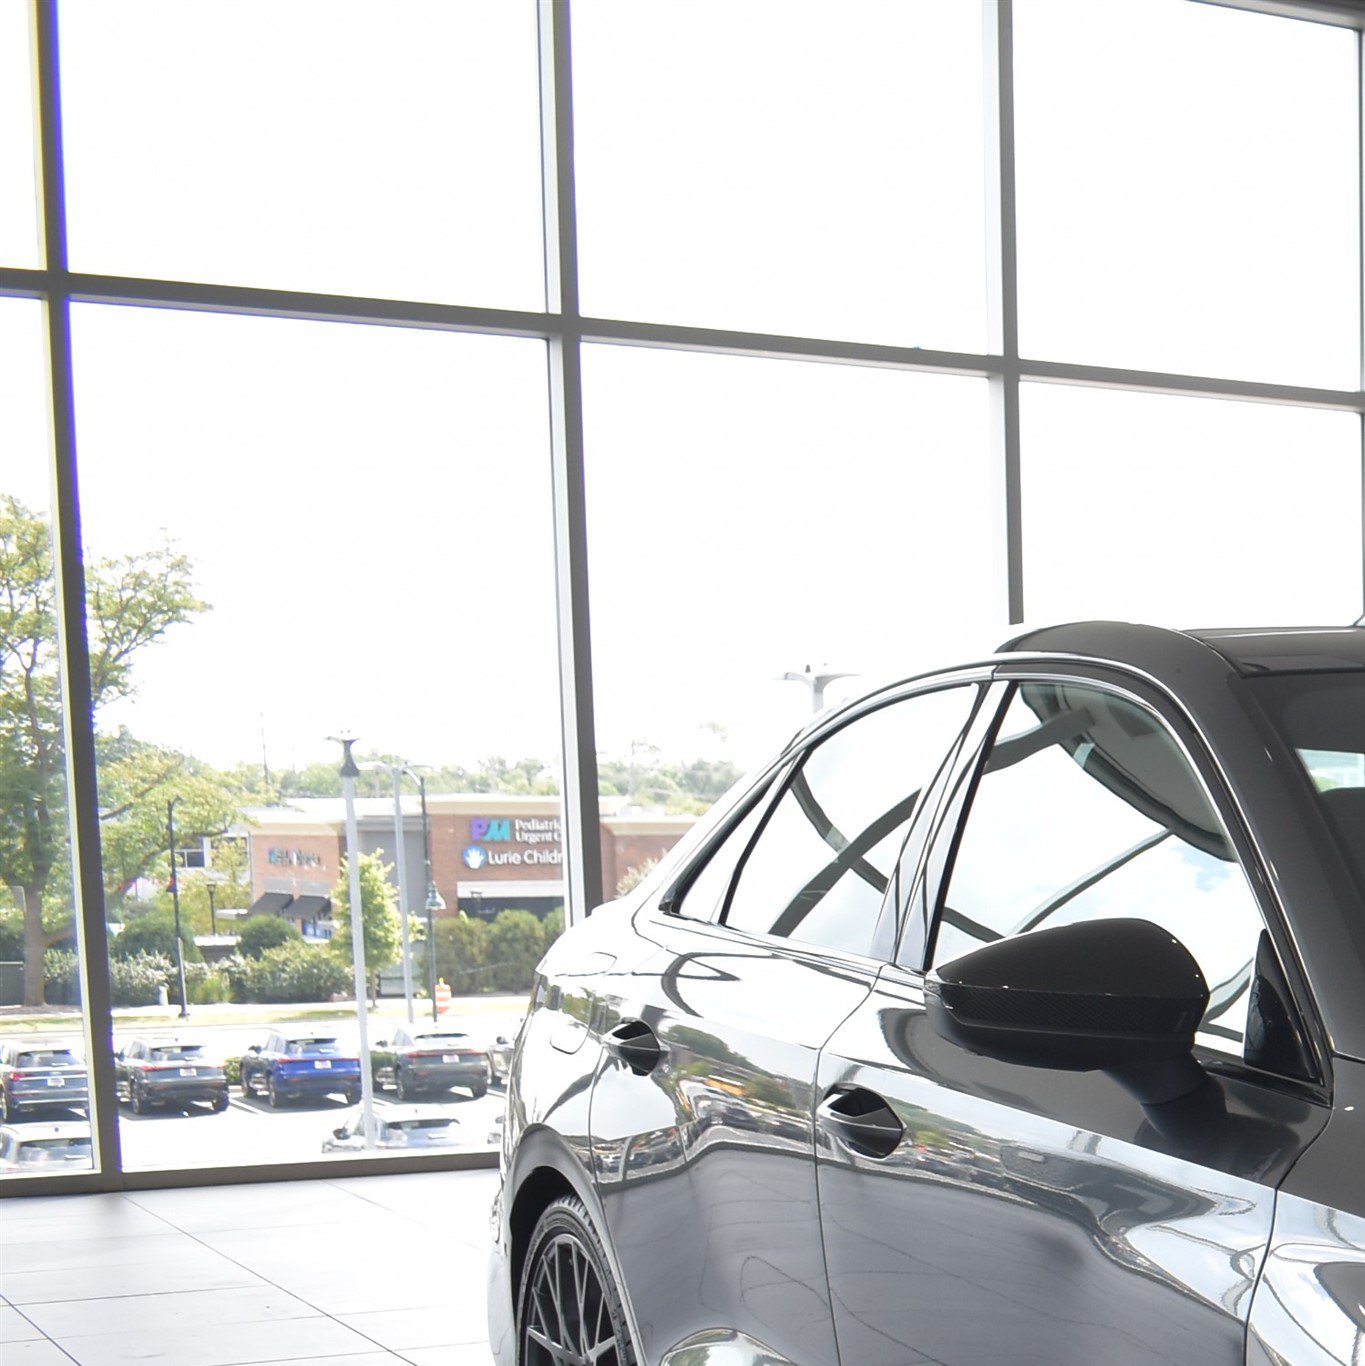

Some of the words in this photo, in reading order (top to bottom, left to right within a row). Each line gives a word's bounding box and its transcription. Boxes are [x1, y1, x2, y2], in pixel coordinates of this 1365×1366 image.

[514, 831, 553, 845] Urgent
[488, 850, 522, 864] Lurie
[523, 848, 563, 865] Childr
